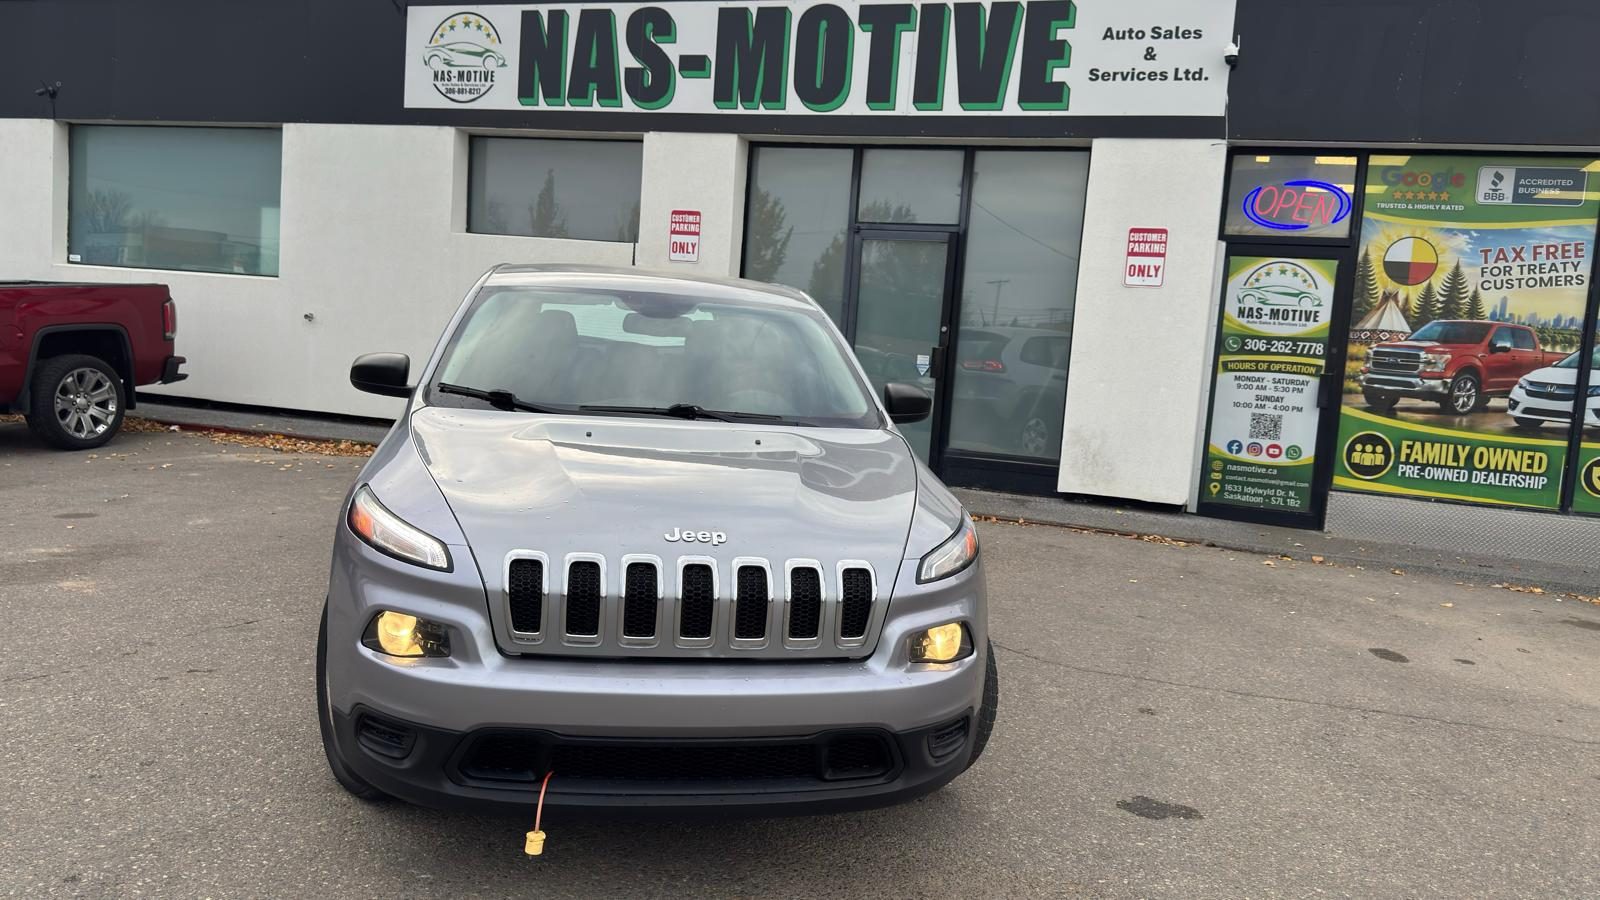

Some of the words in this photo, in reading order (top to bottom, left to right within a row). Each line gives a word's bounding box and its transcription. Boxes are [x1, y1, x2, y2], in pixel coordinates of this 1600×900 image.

[1101, 26, 1146, 41] Auto
[1150, 25, 1203, 41] Sales
[518, 1, 1076, 112] NAS-MOTIVE
[1143, 46, 1157, 61] &
[433, 70, 495, 82] NAS-MOTIVE
[1088, 67, 1169, 83] Services
[1173, 67, 1210, 82] Ltd.
[1519, 178, 1574, 187] ACCREDITED
[1483, 192, 1505, 201] BBB
[1518, 187, 1561, 195] BUSINESS
[1254, 185, 1336, 224] OPEN
[672, 214, 700, 223] CUSTOMER
[671, 223, 700, 232] PARKING
[1129, 232, 1167, 242] CUSTOMER
[671, 241, 697, 255] ONLY
[1128, 242, 1166, 254] PARKING
[1479, 246, 1526, 265] TAX
[1532, 242, 1585, 261] FREE
[1127, 263, 1162, 278] ONLY
[1480, 265, 1513, 278] FOR
[1517, 260, 1582, 276] TREATY
[1480, 274, 1585, 291] CUSTOMERS
[1237, 306, 1320, 322] NAS-MOTIVE
[1244, 339, 1324, 355] 306-262-7778
[1227, 361, 1257, 371] HOURS
[1257, 363, 1268, 371] OF
[1270, 364, 1317, 375] OPERATION
[1233, 375, 1266, 384] MONDAY
[1272, 377, 1311, 387] SATURDAY
[1236, 383, 1254, 391] 9:00
[1254, 384, 1268, 392] AM
[1273, 385, 1291, 393] 5:30
[1291, 386, 1304, 394] PM
[1255, 394, 1285, 404] SUNDAY
[1232, 401, 1254, 409] 10:00
[1272, 404, 1290, 412] 4:00
[1291, 405, 1304, 413] PM
[1400, 440, 1470, 467] FAMILY
[1473, 446, 1548, 474] OWNED
[1226, 463, 1278, 475] nasmotive.ca
[1398, 465, 1468, 482] PRE-OWNED
[1471, 471, 1547, 490] DEALERSHIP
[1224, 483, 1242, 493] 1633
[1243, 485, 1275, 497] Idylwyld
[1276, 489, 1288, 497] Dr.
[1223, 491, 1264, 504] Saskatoon
[1270, 496, 1285, 506] S7L
[1286, 498, 1301, 508] 1B2
[664, 527, 728, 547] Jeep
